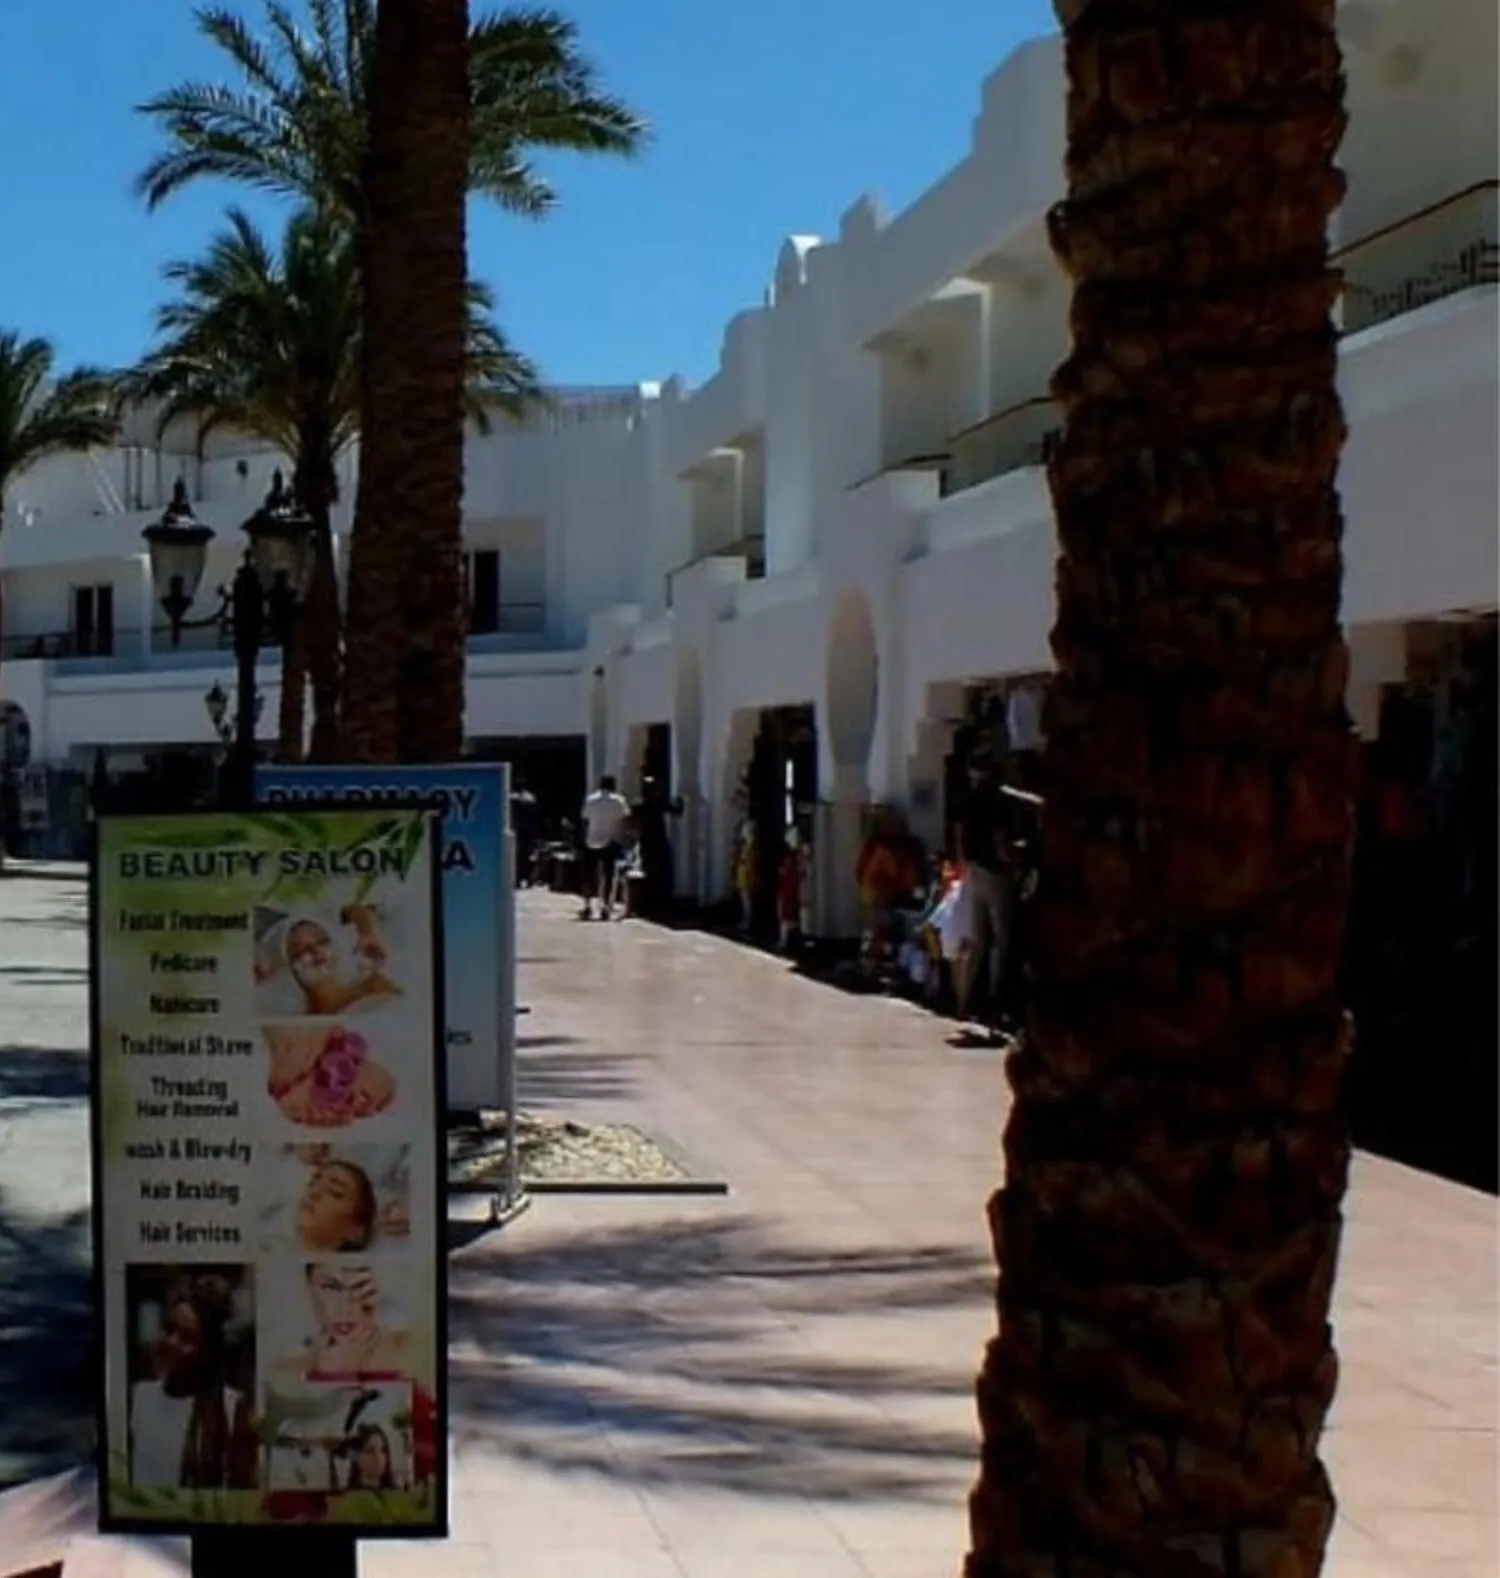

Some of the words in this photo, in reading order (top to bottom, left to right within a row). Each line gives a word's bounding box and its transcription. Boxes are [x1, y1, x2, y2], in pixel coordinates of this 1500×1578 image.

[119, 850, 268, 879] BEAUTY
[279, 847, 402, 875] SALON
[119, 909, 165, 931] Facial
[170, 908, 249, 931] Treatment
[150, 952, 218, 973] Pedicure
[206, 1033, 253, 1056] Shave
[151, 1076, 228, 1101] Threading
[137, 1099, 167, 1117] Hair
[173, 1099, 239, 1117] Removal
[140, 1179, 171, 1200] Hair
[176, 1179, 240, 1206] Braiding
[140, 1220, 170, 1242] Hair
[176, 1220, 241, 1243] Services
